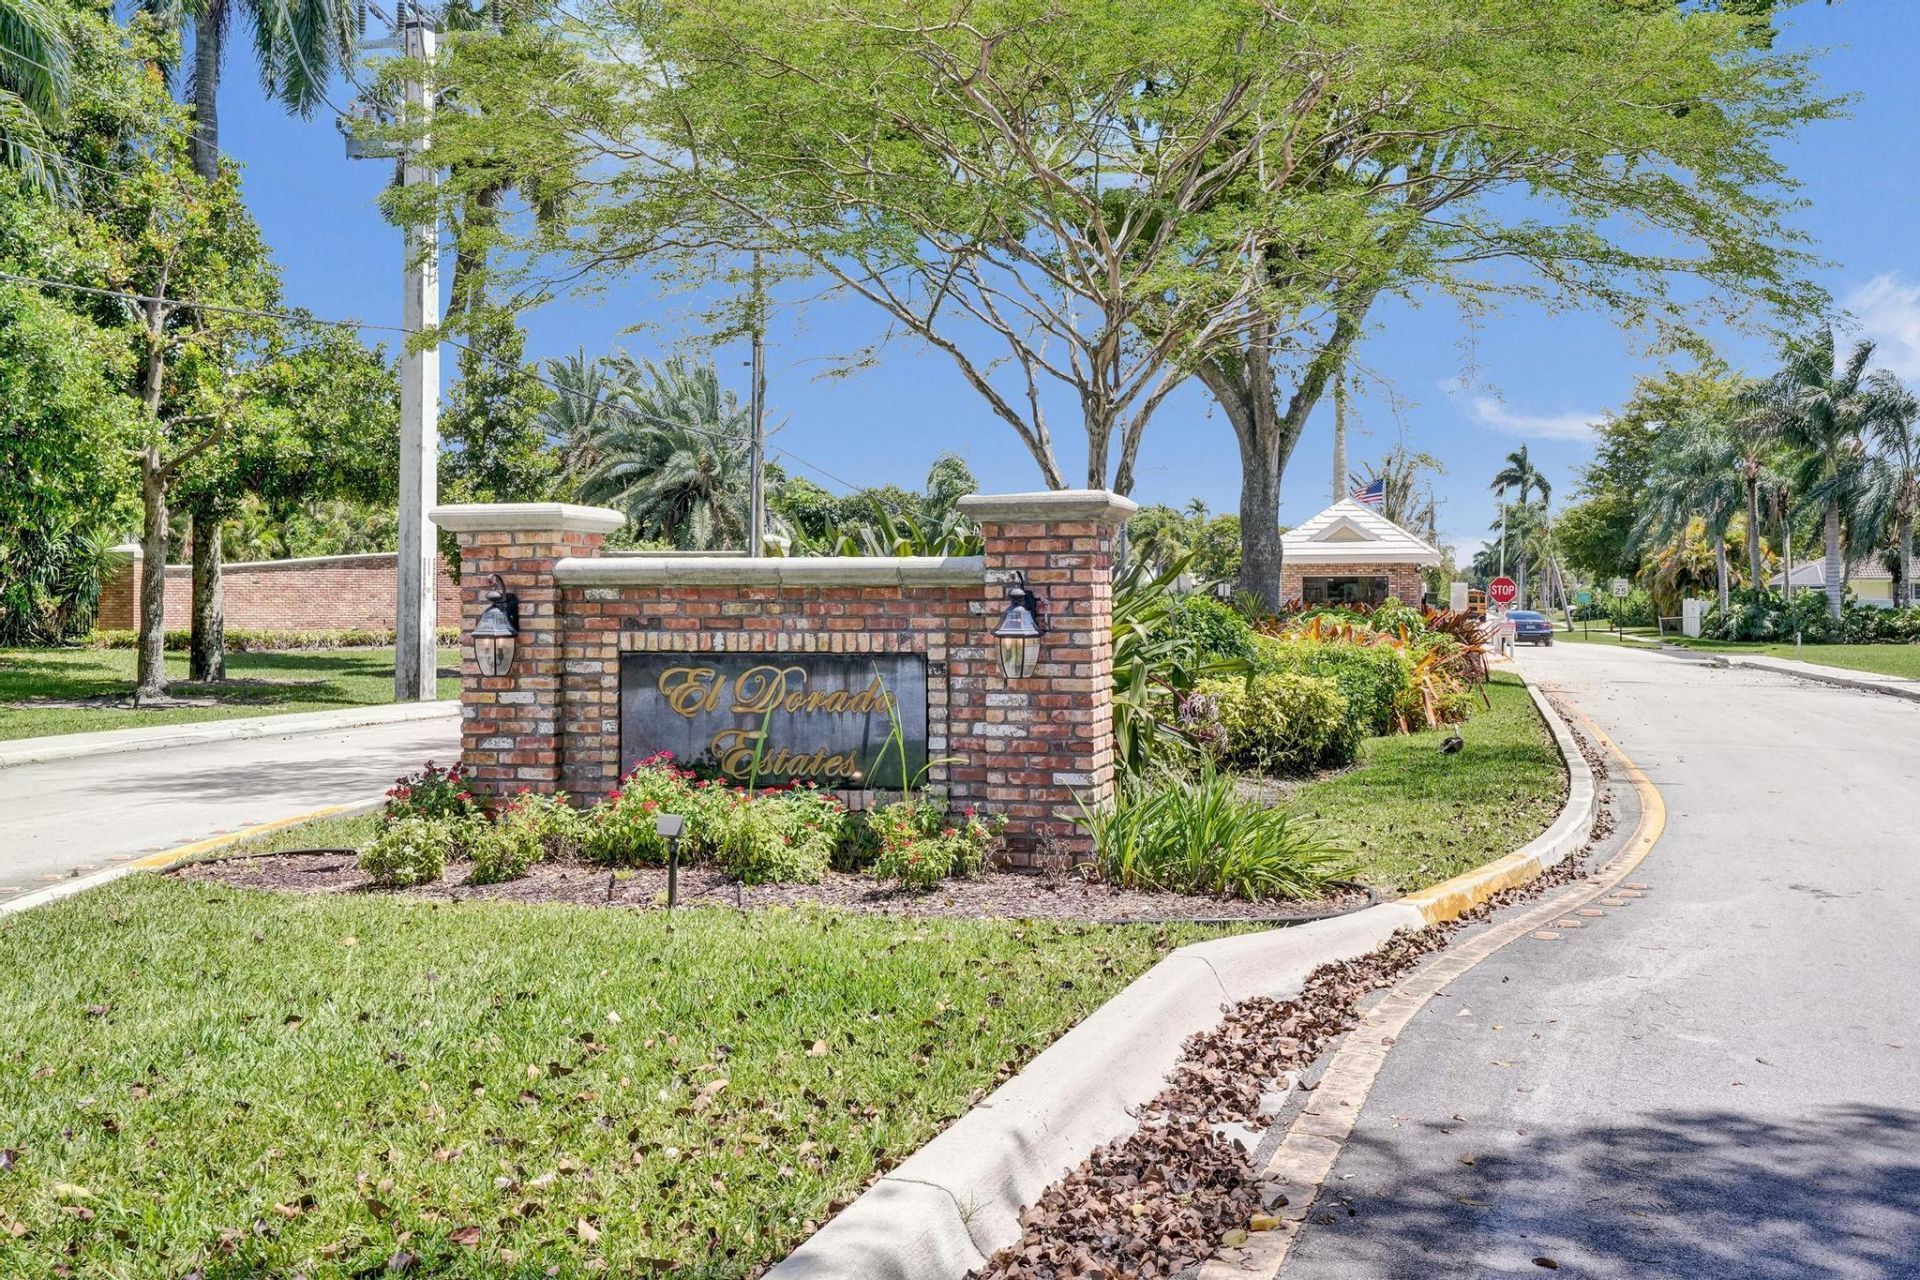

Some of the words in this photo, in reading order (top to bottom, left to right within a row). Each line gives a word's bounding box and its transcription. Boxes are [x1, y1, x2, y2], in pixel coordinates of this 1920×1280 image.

[1491, 585, 1515, 595] STOP
[1615, 587, 1626, 595] 25
[657, 667, 727, 718] El
[731, 665, 897, 714] Dorado
[711, 729, 856, 780] Estates
